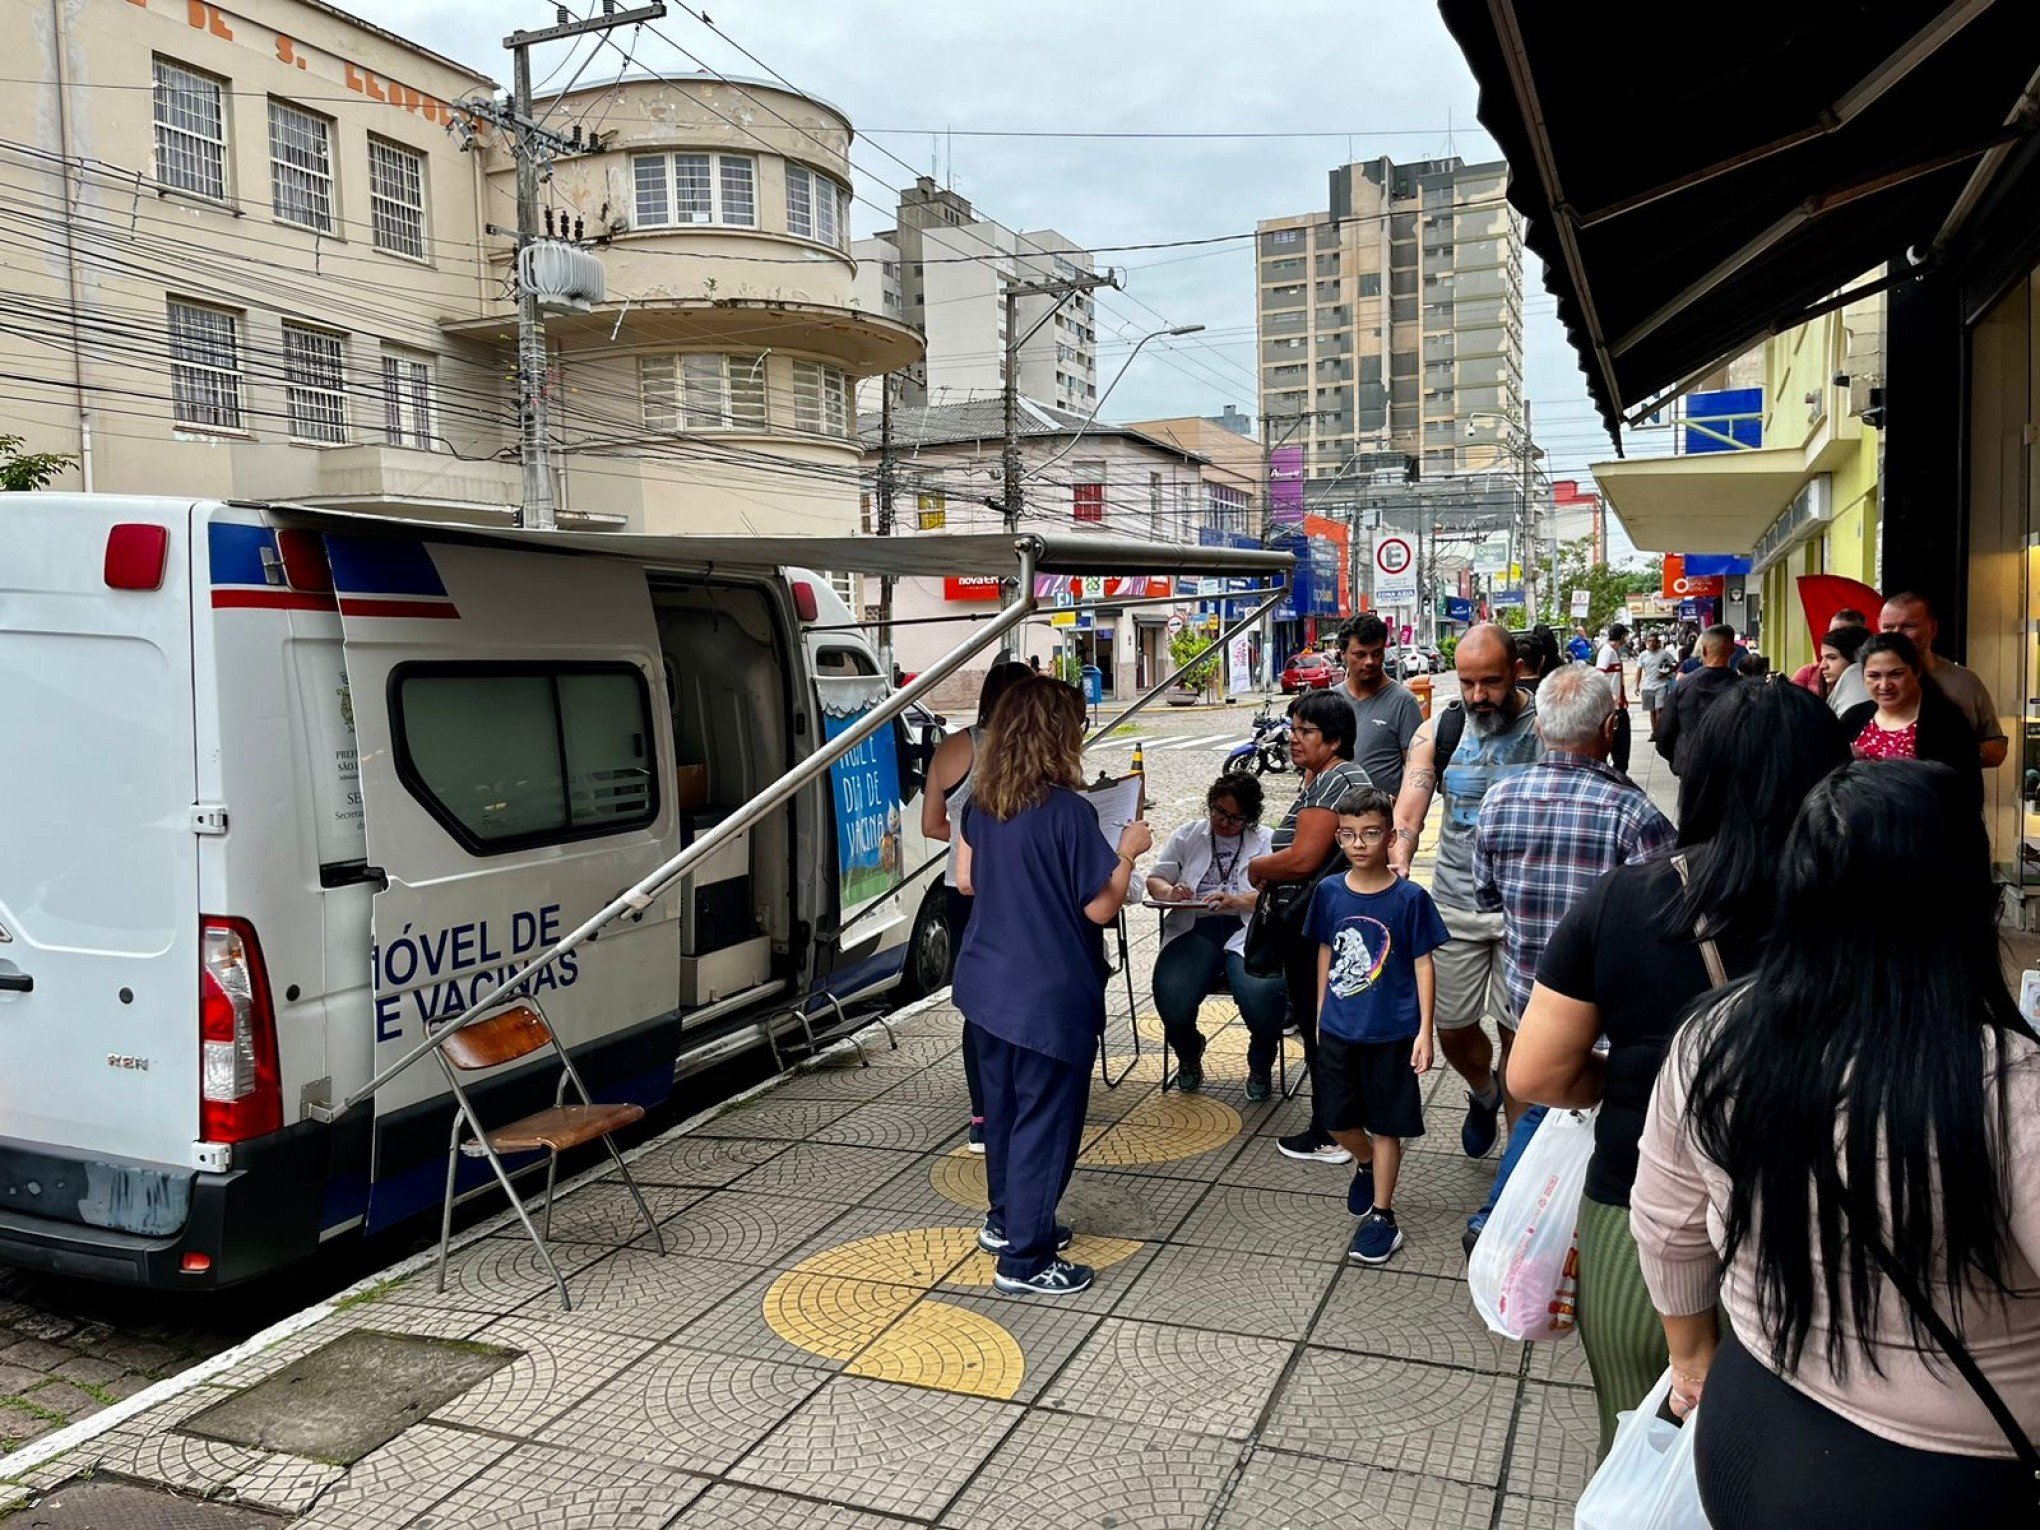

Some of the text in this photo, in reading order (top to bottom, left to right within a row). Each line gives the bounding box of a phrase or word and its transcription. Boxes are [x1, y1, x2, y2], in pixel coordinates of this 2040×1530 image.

[187, 0, 232, 41] DE
[276, 34, 307, 70] S.
[1385, 545, 1402, 567] E
[843, 770, 882, 813] DIA DE
[512, 904, 561, 955] DE
